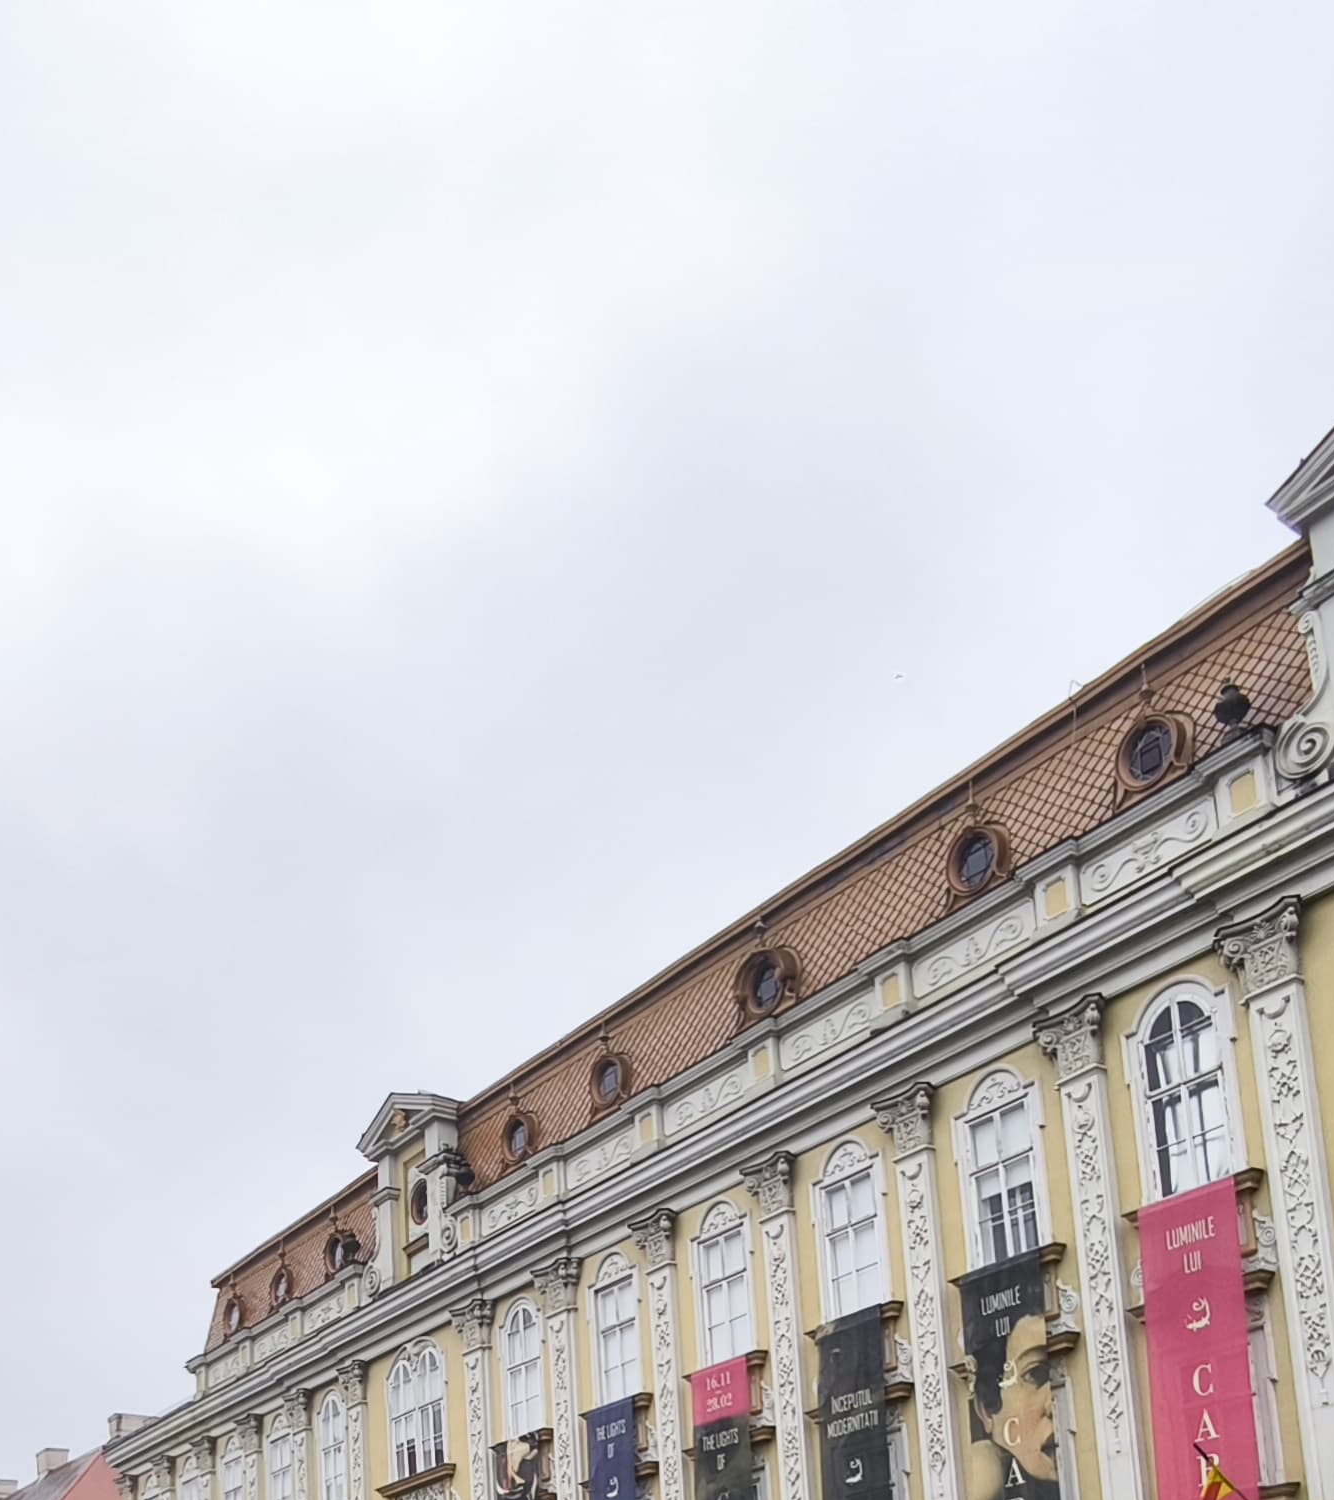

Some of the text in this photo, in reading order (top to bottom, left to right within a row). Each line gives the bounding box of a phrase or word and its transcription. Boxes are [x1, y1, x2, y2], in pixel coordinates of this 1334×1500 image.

[1166, 1216, 1216, 1251] LUMINILE
[1183, 1250, 1202, 1274] LUI
[980, 1285, 1022, 1316] LUMINILE
[995, 1316, 1011, 1337] LUI
[706, 1371, 732, 1392] 16.11
[706, 1392, 734, 1413] 28.02
[702, 1428, 739, 1452] THE LIGHTS
[716, 1453, 726, 1471] OF
